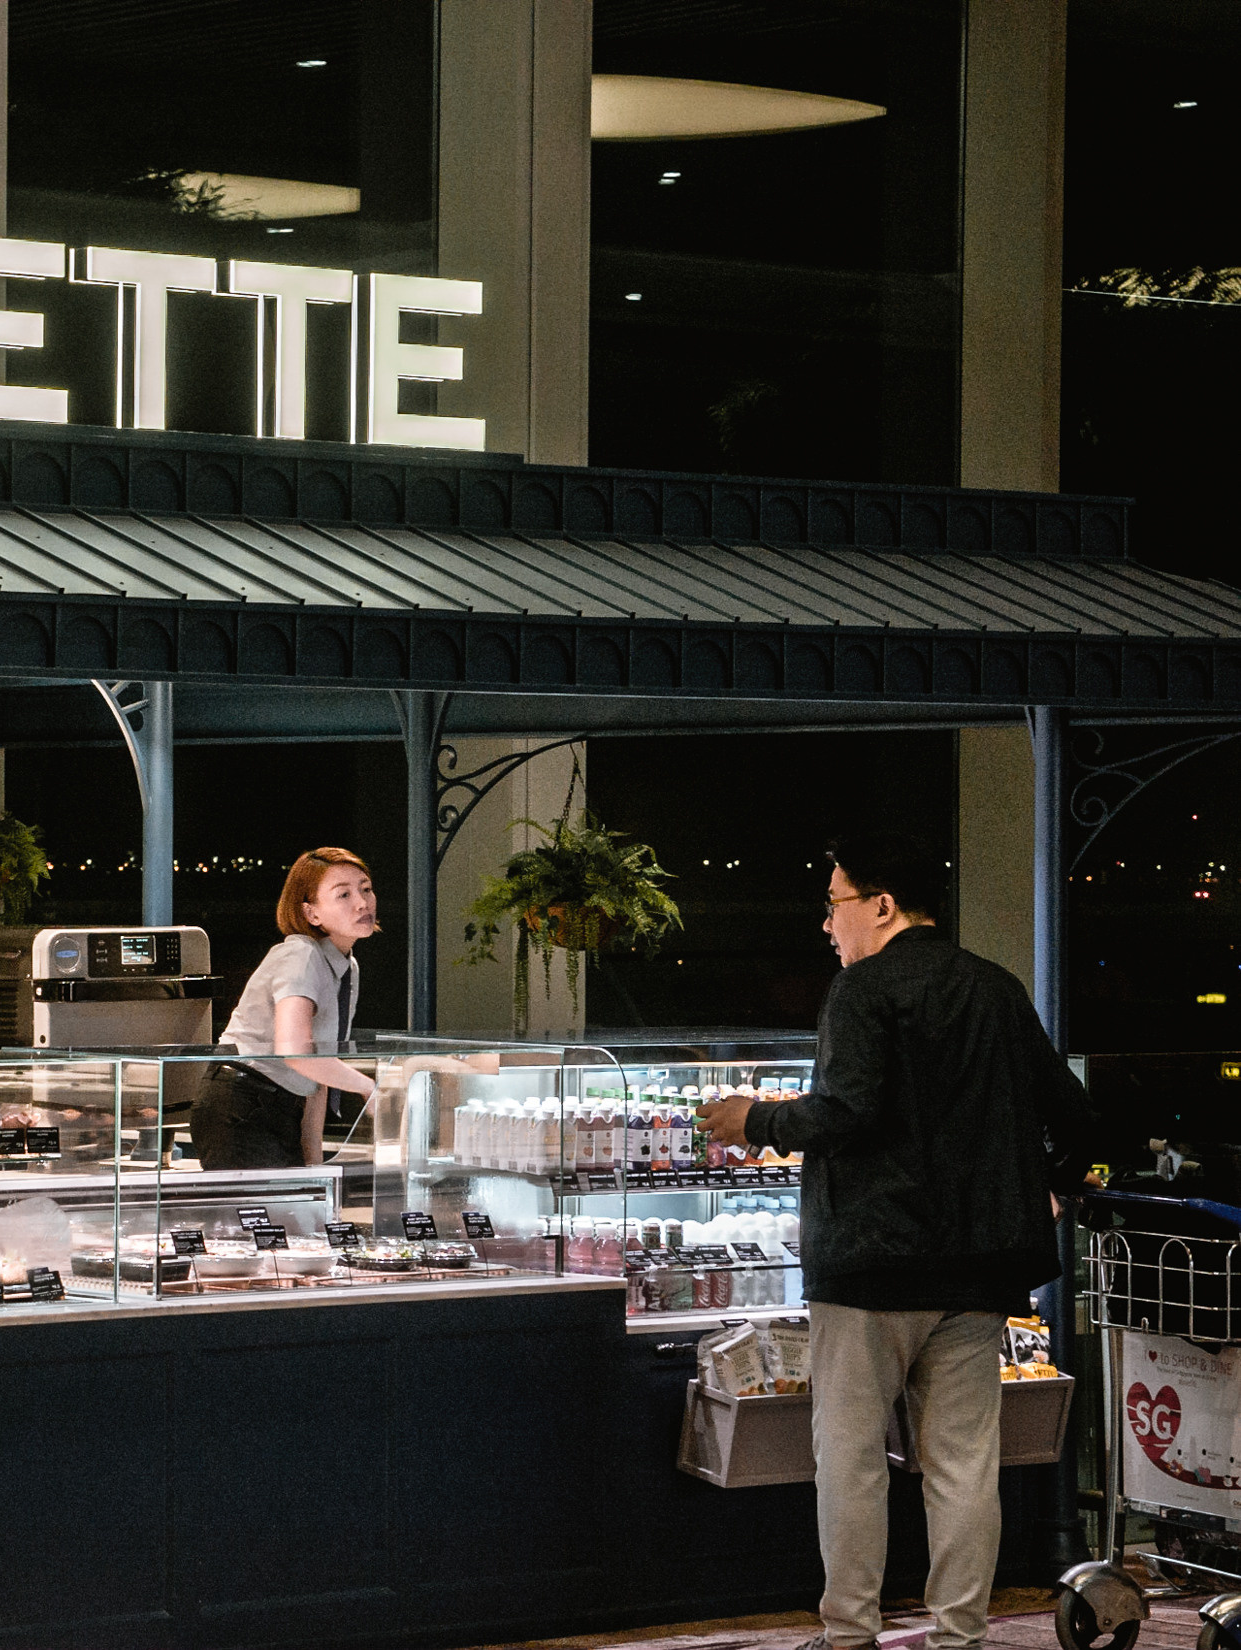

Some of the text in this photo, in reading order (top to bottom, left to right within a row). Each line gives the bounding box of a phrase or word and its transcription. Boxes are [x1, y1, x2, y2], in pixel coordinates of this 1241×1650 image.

[1160, 1352, 1170, 1366] to
[1172, 1353, 1198, 1369] SHOP
[1200, 1358, 1208, 1372] &
[1135, 1400, 1173, 1441] SG
